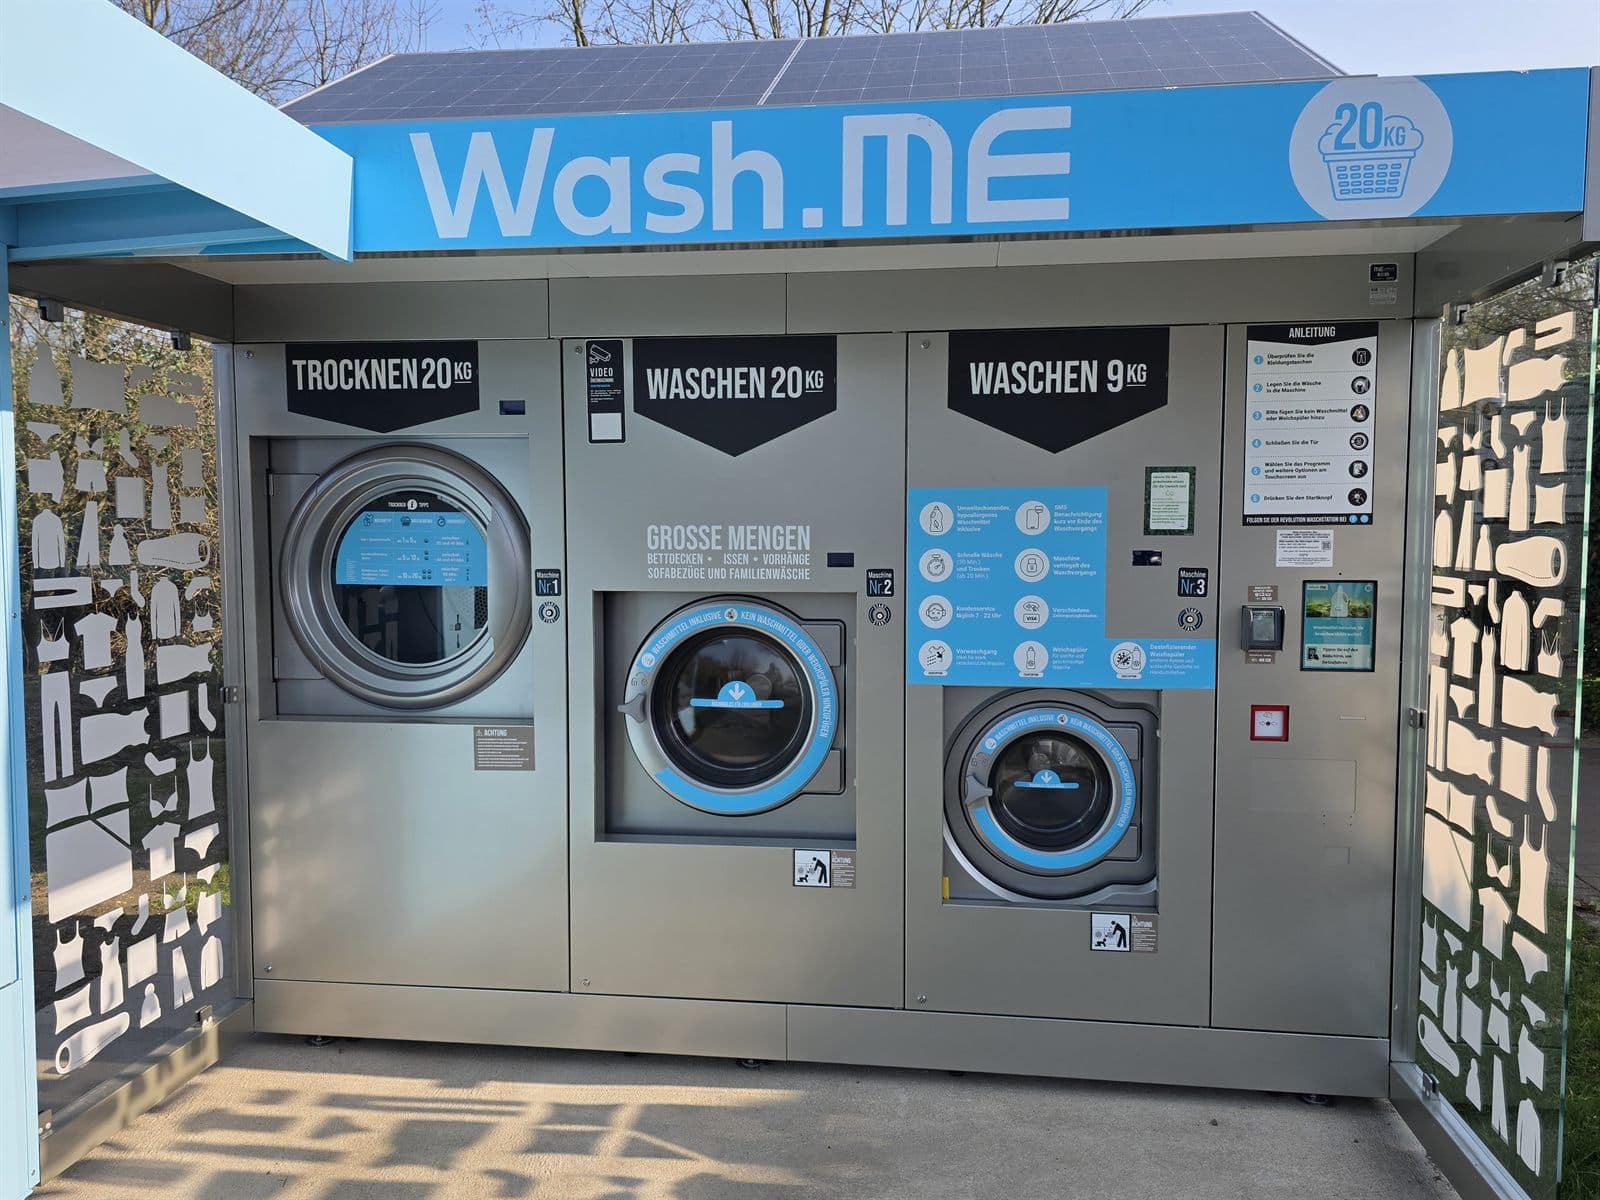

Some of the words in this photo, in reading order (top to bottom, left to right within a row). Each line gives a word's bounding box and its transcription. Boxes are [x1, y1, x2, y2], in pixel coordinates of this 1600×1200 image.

[1289, 326, 1336, 338] ANLEITUNG
[292, 358, 417, 391] TROCKNEN
[421, 357, 451, 390] 20
[454, 361, 472, 380] KG
[590, 367, 613, 377] VIDEO
[969, 359, 1098, 395] WASCHEN
[1106, 359, 1124, 393] 9
[1126, 363, 1148, 384] KG
[646, 366, 766, 400] WASCHEN
[771, 366, 802, 399] 20
[805, 370, 824, 390] KG
[1053, 525, 1097, 533] Waschvorgangs
[647, 525, 722, 551] GROSSE
[728, 525, 810, 551] MENGEN
[647, 553, 703, 565] BETTDECKEN
[762, 552, 810, 566] VORHÄNGE
[536, 571, 559, 579] Maschine
[647, 566, 705, 580] SOFABEZÜGE
[708, 567, 727, 579] UND
[729, 566, 810, 580] FAMILIENWÄSCHE
[867, 571, 892, 579] Maschine
[1180, 570, 1206, 578] Maschine
[652, 621, 688, 654] WASCHMITTEL
[689, 610, 722, 626] INKLUSIVE
[741, 610, 756, 621] KEIN
[757, 612, 797, 643] WASCHMITTEL
[796, 639, 811, 657] ODER
[807, 654, 830, 699] WEICHSPÜLER
[819, 697, 832, 738] HINZUFÜGEN
[483, 729, 508, 737] ACHTUNG
